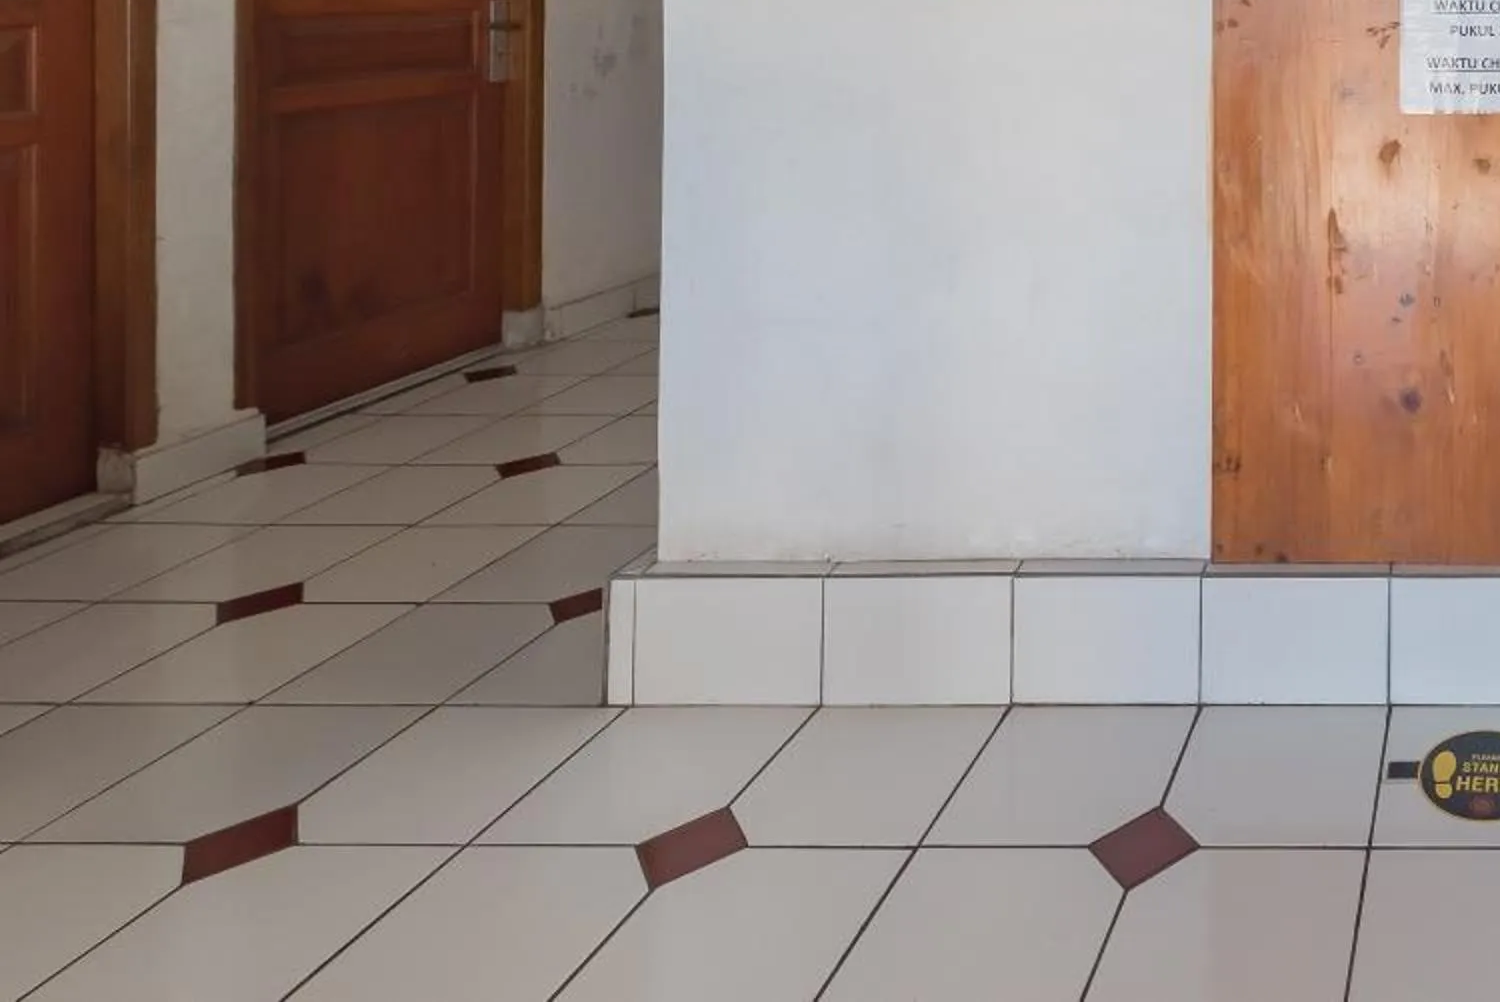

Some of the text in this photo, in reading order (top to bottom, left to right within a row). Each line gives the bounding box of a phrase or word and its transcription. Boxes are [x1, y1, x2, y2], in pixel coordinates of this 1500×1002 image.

[1434, 0, 1486, 13] WAKTU
[1450, 25, 1495, 37] PUKUL
[1427, 57, 1477, 69] WAKTU
[1430, 82, 1465, 95] MAX.
